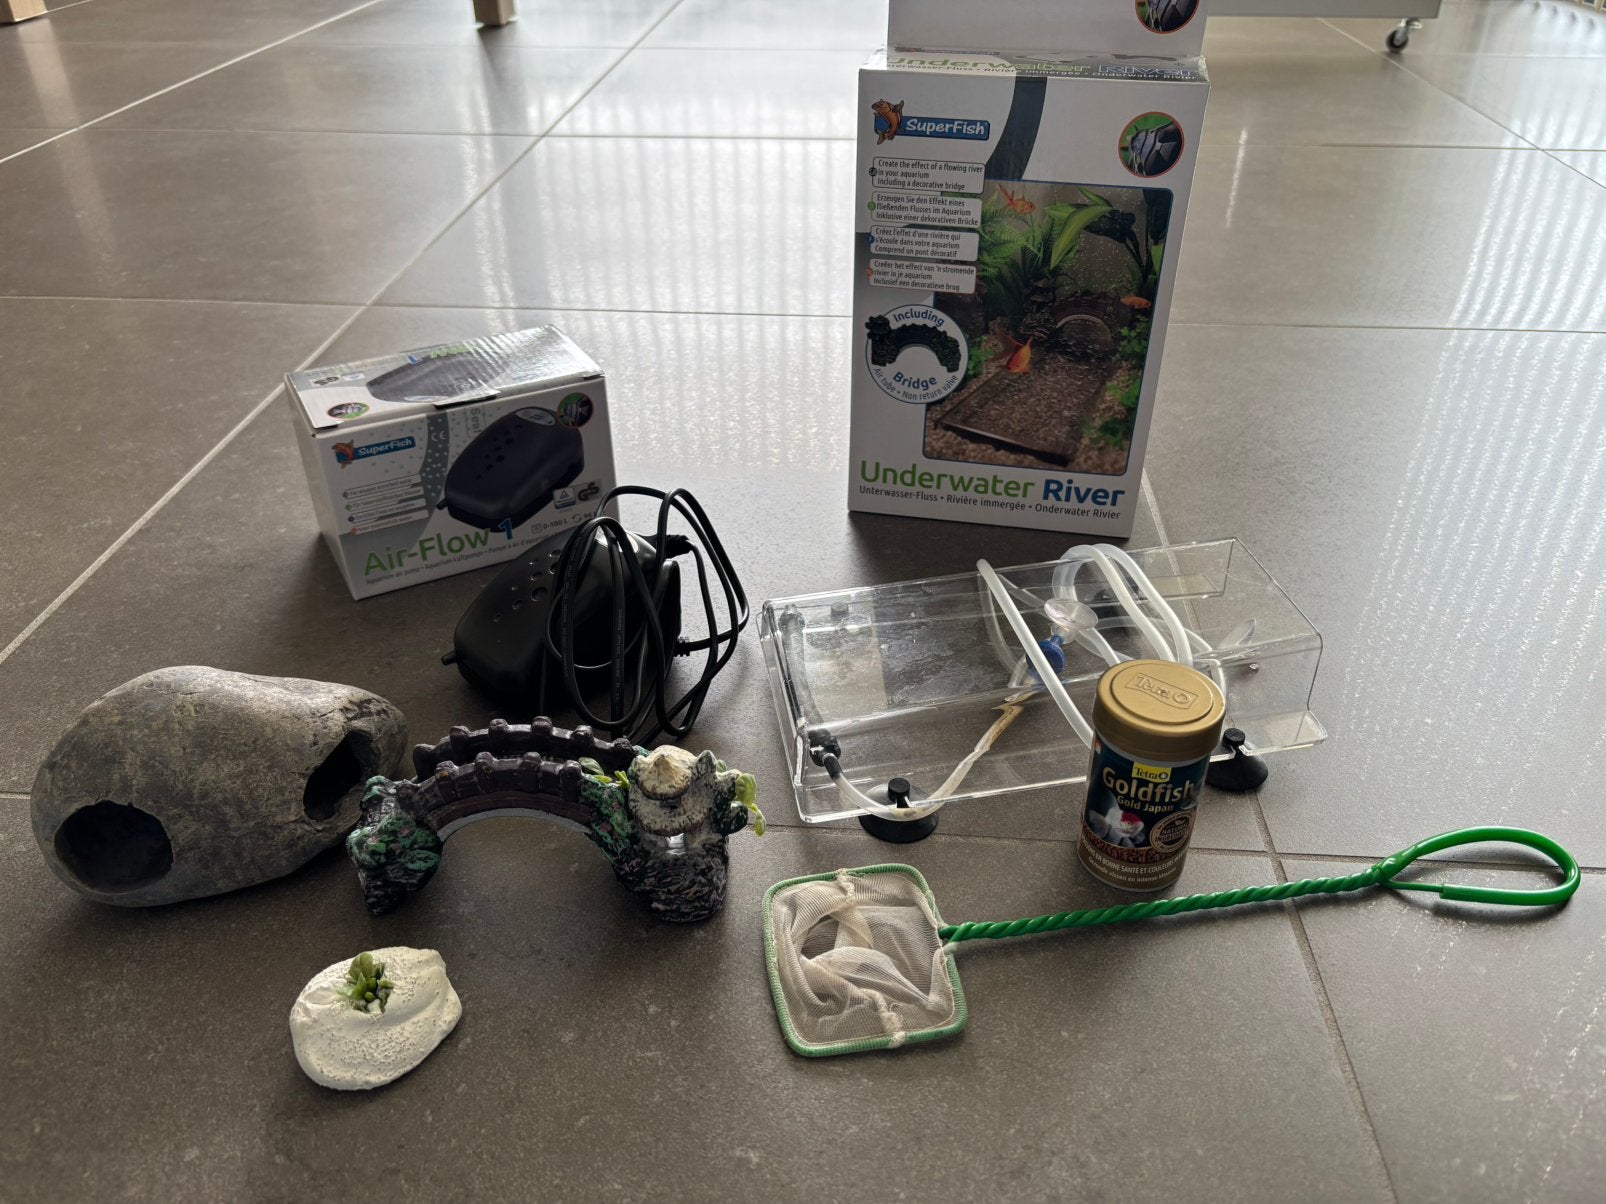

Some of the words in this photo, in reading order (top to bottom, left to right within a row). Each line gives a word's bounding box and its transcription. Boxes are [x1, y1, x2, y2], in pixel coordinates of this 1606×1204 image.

[906, 118, 985, 135] SuperFish
[878, 160, 899, 168] Create
[899, 161, 910, 169] the
[911, 161, 929, 170] effect
[931, 161, 938, 170] of
[943, 163, 967, 174] flowing
[968, 165, 983, 173] river
[900, 170, 929, 179] aquarium
[877, 178, 906, 187] Including
[912, 179, 944, 189] decorative
[944, 181, 965, 191] bridge
[877, 194, 904, 203] Erzeugen
[918, 196, 928, 204] den
[929, 197, 947, 206] Effekt
[948, 199, 965, 207] eines
[910, 204, 931, 214] Flusses
[933, 206, 940, 214] im
[941, 207, 971, 216] Aquarium
[876, 212, 902, 221] Inklusive
[920, 214, 956, 224] dekorativen
[957, 217, 978, 226] Brücke
[912, 229, 928, 238] d'une
[951, 233, 960, 242] qui
[914, 238, 930, 247] votre
[931, 241, 960, 249] aquarium
[875, 245, 905, 254] Comprend
[915, 248, 929, 256] pont
[930, 248, 958, 258] décoratif
[891, 269, 897, 277] in
[897, 270, 904, 278] je
[904, 273, 933, 281] aquarium
[894, 261, 904, 269] het
[905, 262, 923, 270] effect
[942, 265, 975, 275] stromende
[873, 277, 898, 286] Inclusief
[911, 281, 945, 290] decoratieve
[893, 308, 945, 327] Including
[873, 368, 884, 378] Air
[902, 390, 918, 400] Non
[919, 388, 944, 400] return
[942, 375, 959, 391] valve
[893, 371, 937, 391] Bridge
[861, 460, 1035, 498] Underwater
[1042, 478, 1126, 507] River
[859, 485, 938, 502] Unterwasser-Fluss
[946, 494, 978, 506] Rivière
[980, 498, 1026, 512] immergée
[1035, 503, 1091, 517] Onderwater
[1093, 508, 1121, 519] Rivier
[364, 528, 491, 576] Air-Flow
[498, 517, 513, 540] 1
[1135, 767, 1158, 780] Tetra
[1103, 766, 1194, 803] Goldfish
[1117, 795, 1141, 810] Gold
[1143, 803, 1174, 814] Japan
